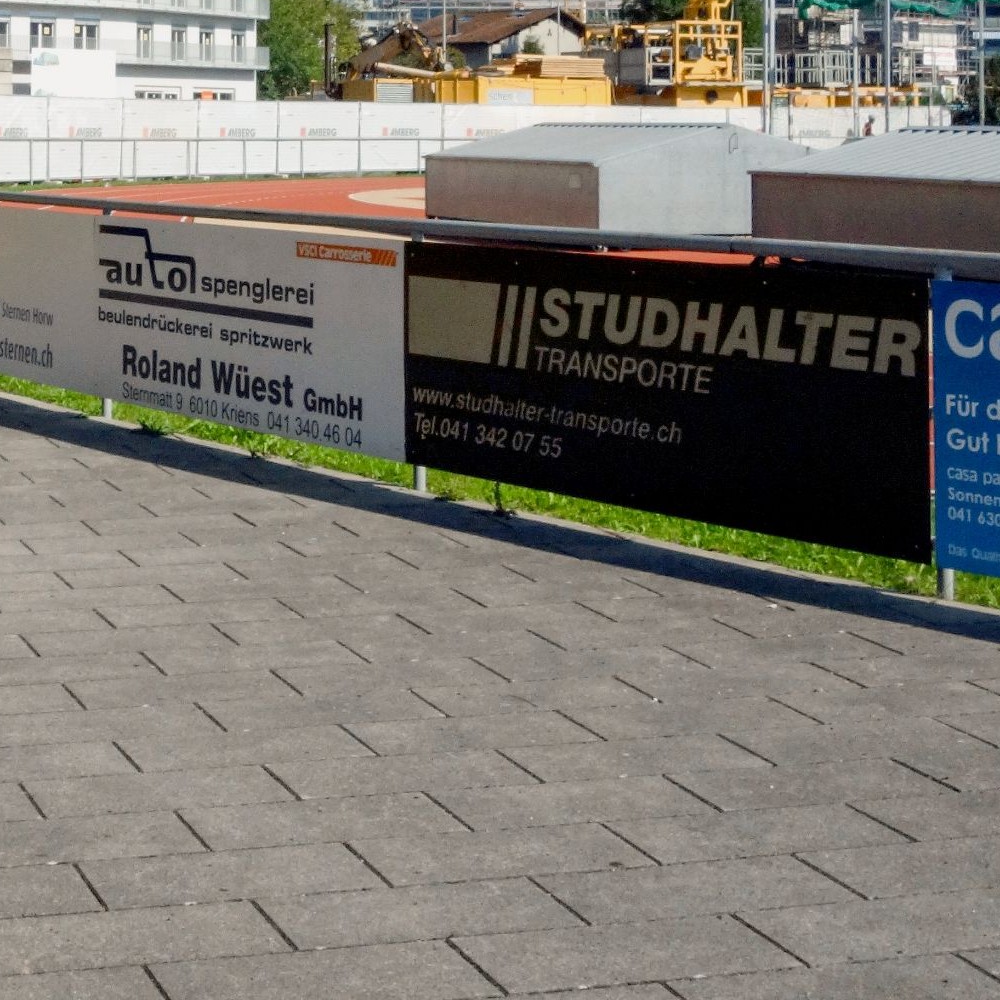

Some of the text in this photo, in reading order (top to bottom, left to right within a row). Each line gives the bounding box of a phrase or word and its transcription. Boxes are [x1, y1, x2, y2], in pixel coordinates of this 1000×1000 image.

[3, 127, 28, 137] AMBERG
[76, 127, 103, 137] AMBERG
[150, 128, 177, 138] AMBERG
[228, 128, 256, 137] AMBERG
[308, 128, 337, 137] AMBERG
[390, 128, 420, 137] AMBERG
[299, 244, 372, 263] VSCI Carrosserie
[201, 275, 315, 306] spenglerei
[2, 302, 31, 322] Sternen
[32, 308, 54, 326] Horw
[98, 306, 313, 356] beulendrückerei spritzwerk
[540, 287, 922, 377] STUDHALTER
[534, 345, 714, 395] TRANSPORTE
[122, 344, 363, 421] Roland Wüest GmbH
[122, 381, 174, 407] Sternmatt
[176, 392, 183, 410] 9
[189, 395, 218, 418] 6010
[221, 404, 260, 426] Kriens
[267, 411, 290, 433] 041
[345, 426, 363, 449] 04
[413, 386, 682, 445] www.studhalter-transporte.ch
[945, 393, 979, 418] Für
[475, 423, 506, 448] 342
[512, 431, 535, 452] 07
[539, 435, 563, 458] 55
[946, 428, 989, 454] Gut
[947, 467, 978, 483] casa
[947, 506, 972, 522] 041
[948, 543, 967, 558] Das
